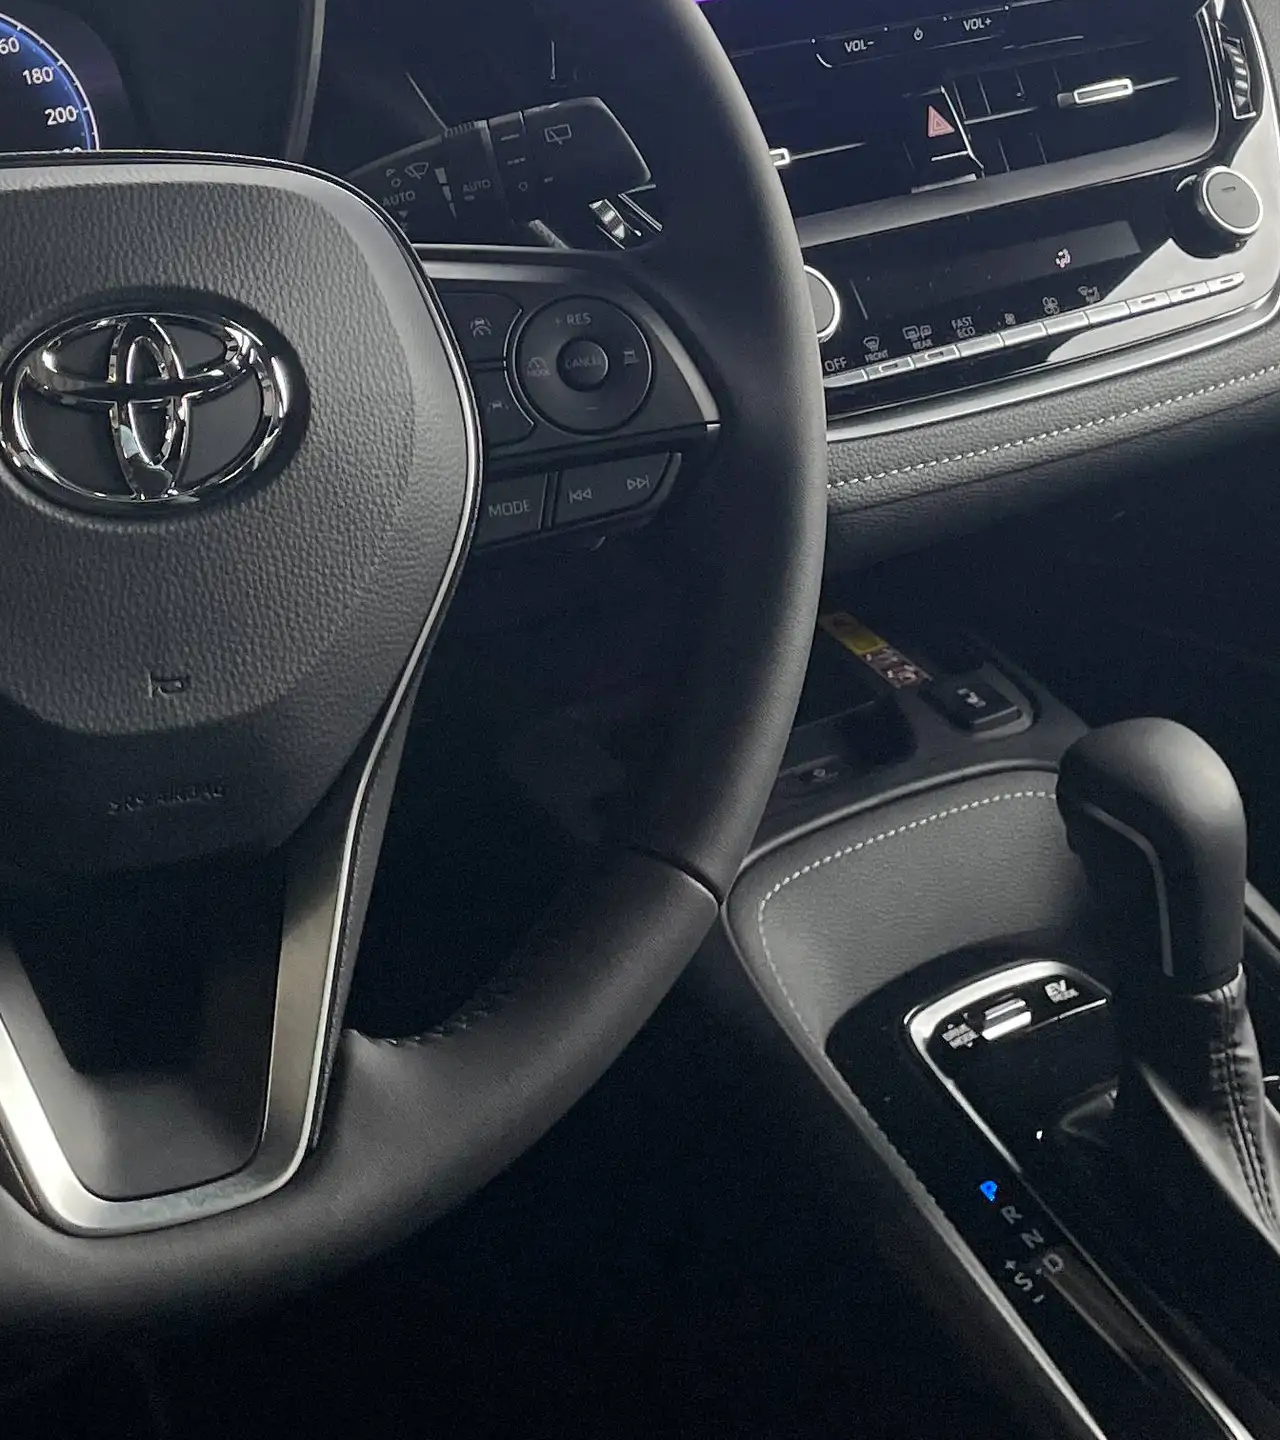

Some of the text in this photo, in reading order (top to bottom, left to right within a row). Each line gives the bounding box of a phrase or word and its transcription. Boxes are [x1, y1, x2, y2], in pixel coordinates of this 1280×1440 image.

[963, 17, 992, 31] VOL+
[22, 66, 54, 86] 180
[44, 105, 77, 126] 200
[462, 179, 491, 192] AUTO
[382, 190, 416, 207] AUTO
[951, 316, 974, 330] FAST
[956, 326, 976, 339] ECO
[912, 339, 933, 350] REAR
[824, 356, 847, 372] OFF
[864, 349, 888, 362] FRONT
[488, 500, 530, 518] MODE
[980, 1180, 997, 1201] P
[1001, 1206, 1023, 1225] R
[1021, 1228, 1044, 1249] N
[1043, 1253, 1064, 1274] D
[1014, 1271, 1033, 1291] S
